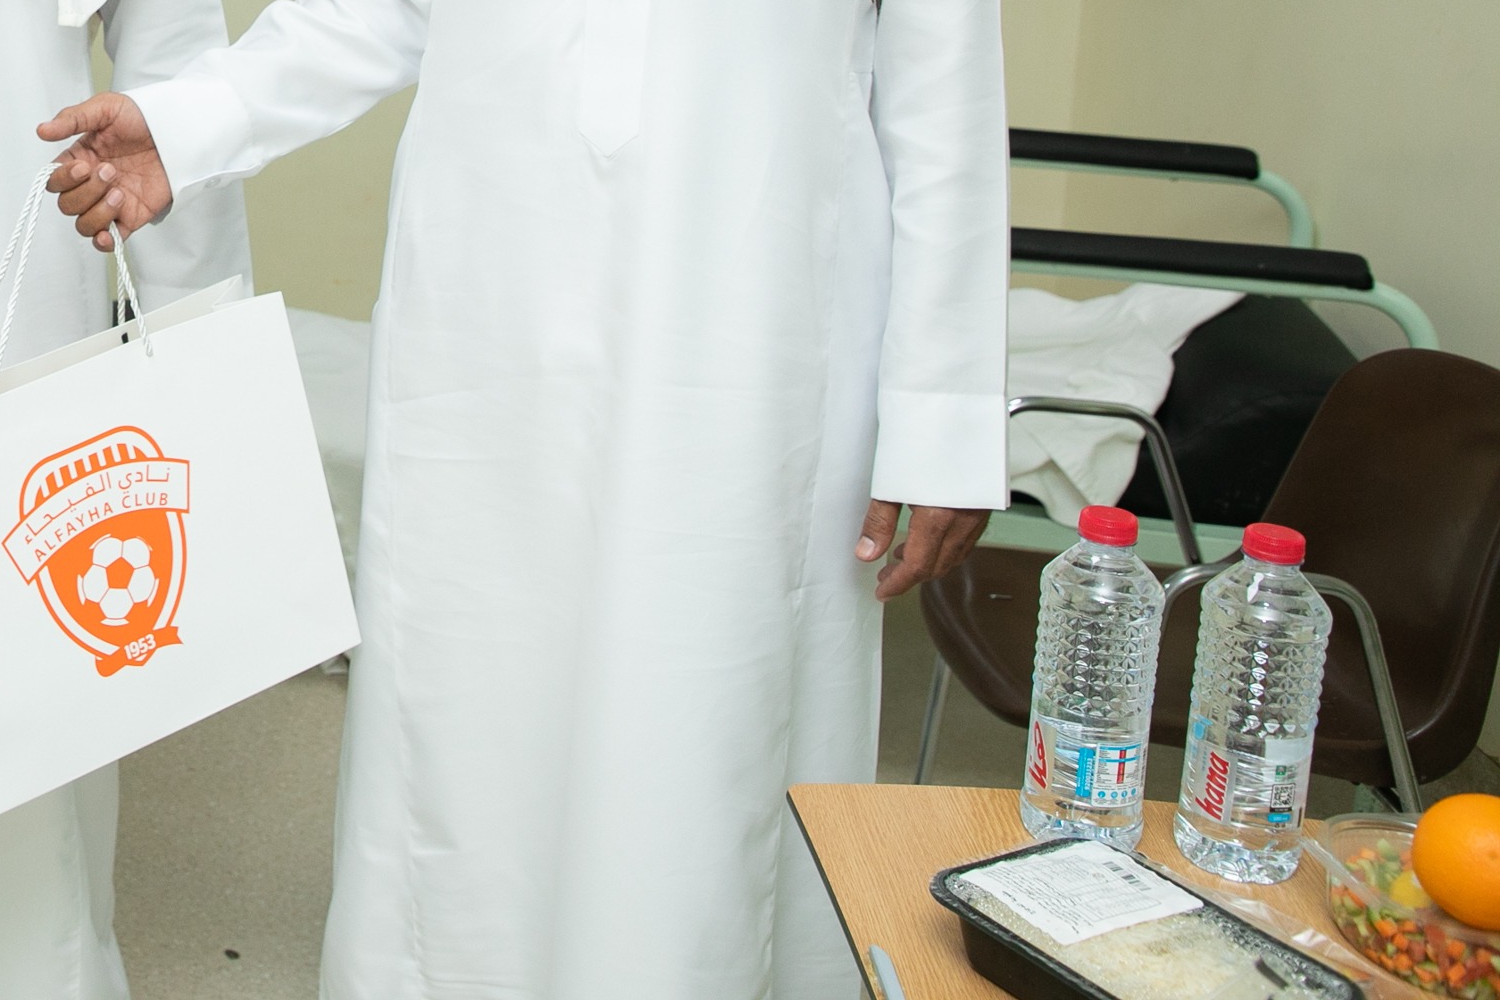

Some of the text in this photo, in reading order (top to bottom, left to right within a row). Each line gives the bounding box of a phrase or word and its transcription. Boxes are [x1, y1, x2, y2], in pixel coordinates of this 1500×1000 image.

[24, 464, 171, 545] نادي الفيحاء
[34, 492, 169, 562] ALFAYHA CLUB
[124, 633, 157, 660] 1953
[1195, 751, 1230, 821] hana
